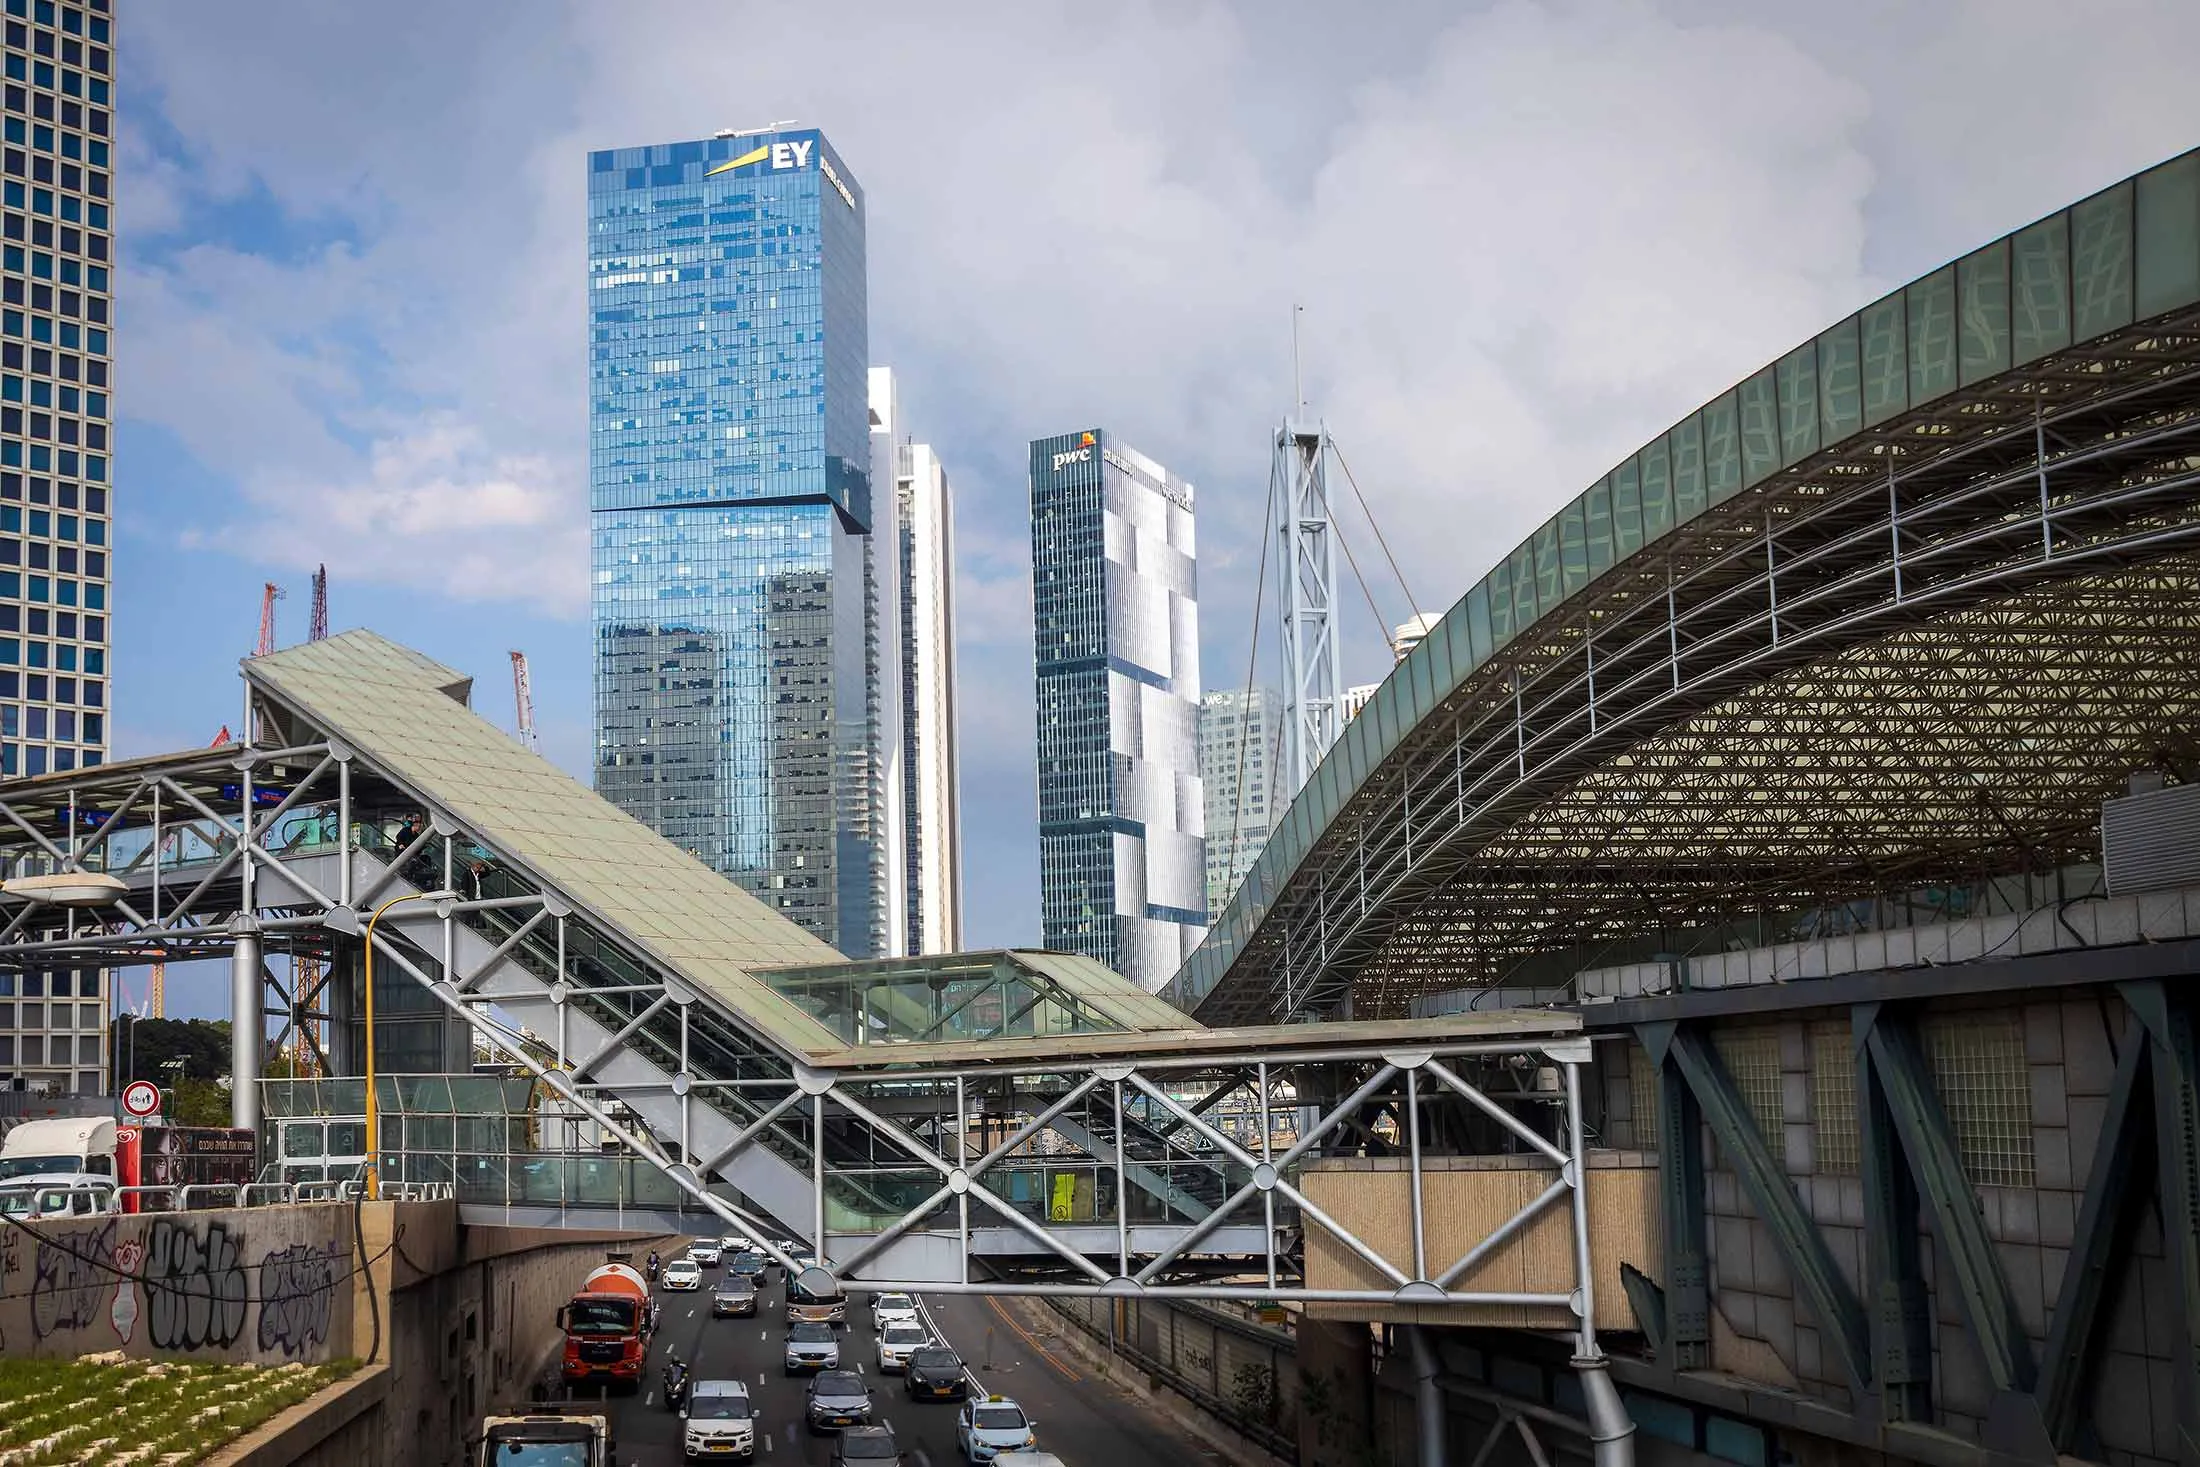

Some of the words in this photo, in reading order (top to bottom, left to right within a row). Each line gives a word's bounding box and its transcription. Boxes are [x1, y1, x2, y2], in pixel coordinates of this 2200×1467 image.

[772, 140, 813, 169] EY
[1052, 448, 1090, 472] pwc
[1202, 1138, 1207, 1147] 3
